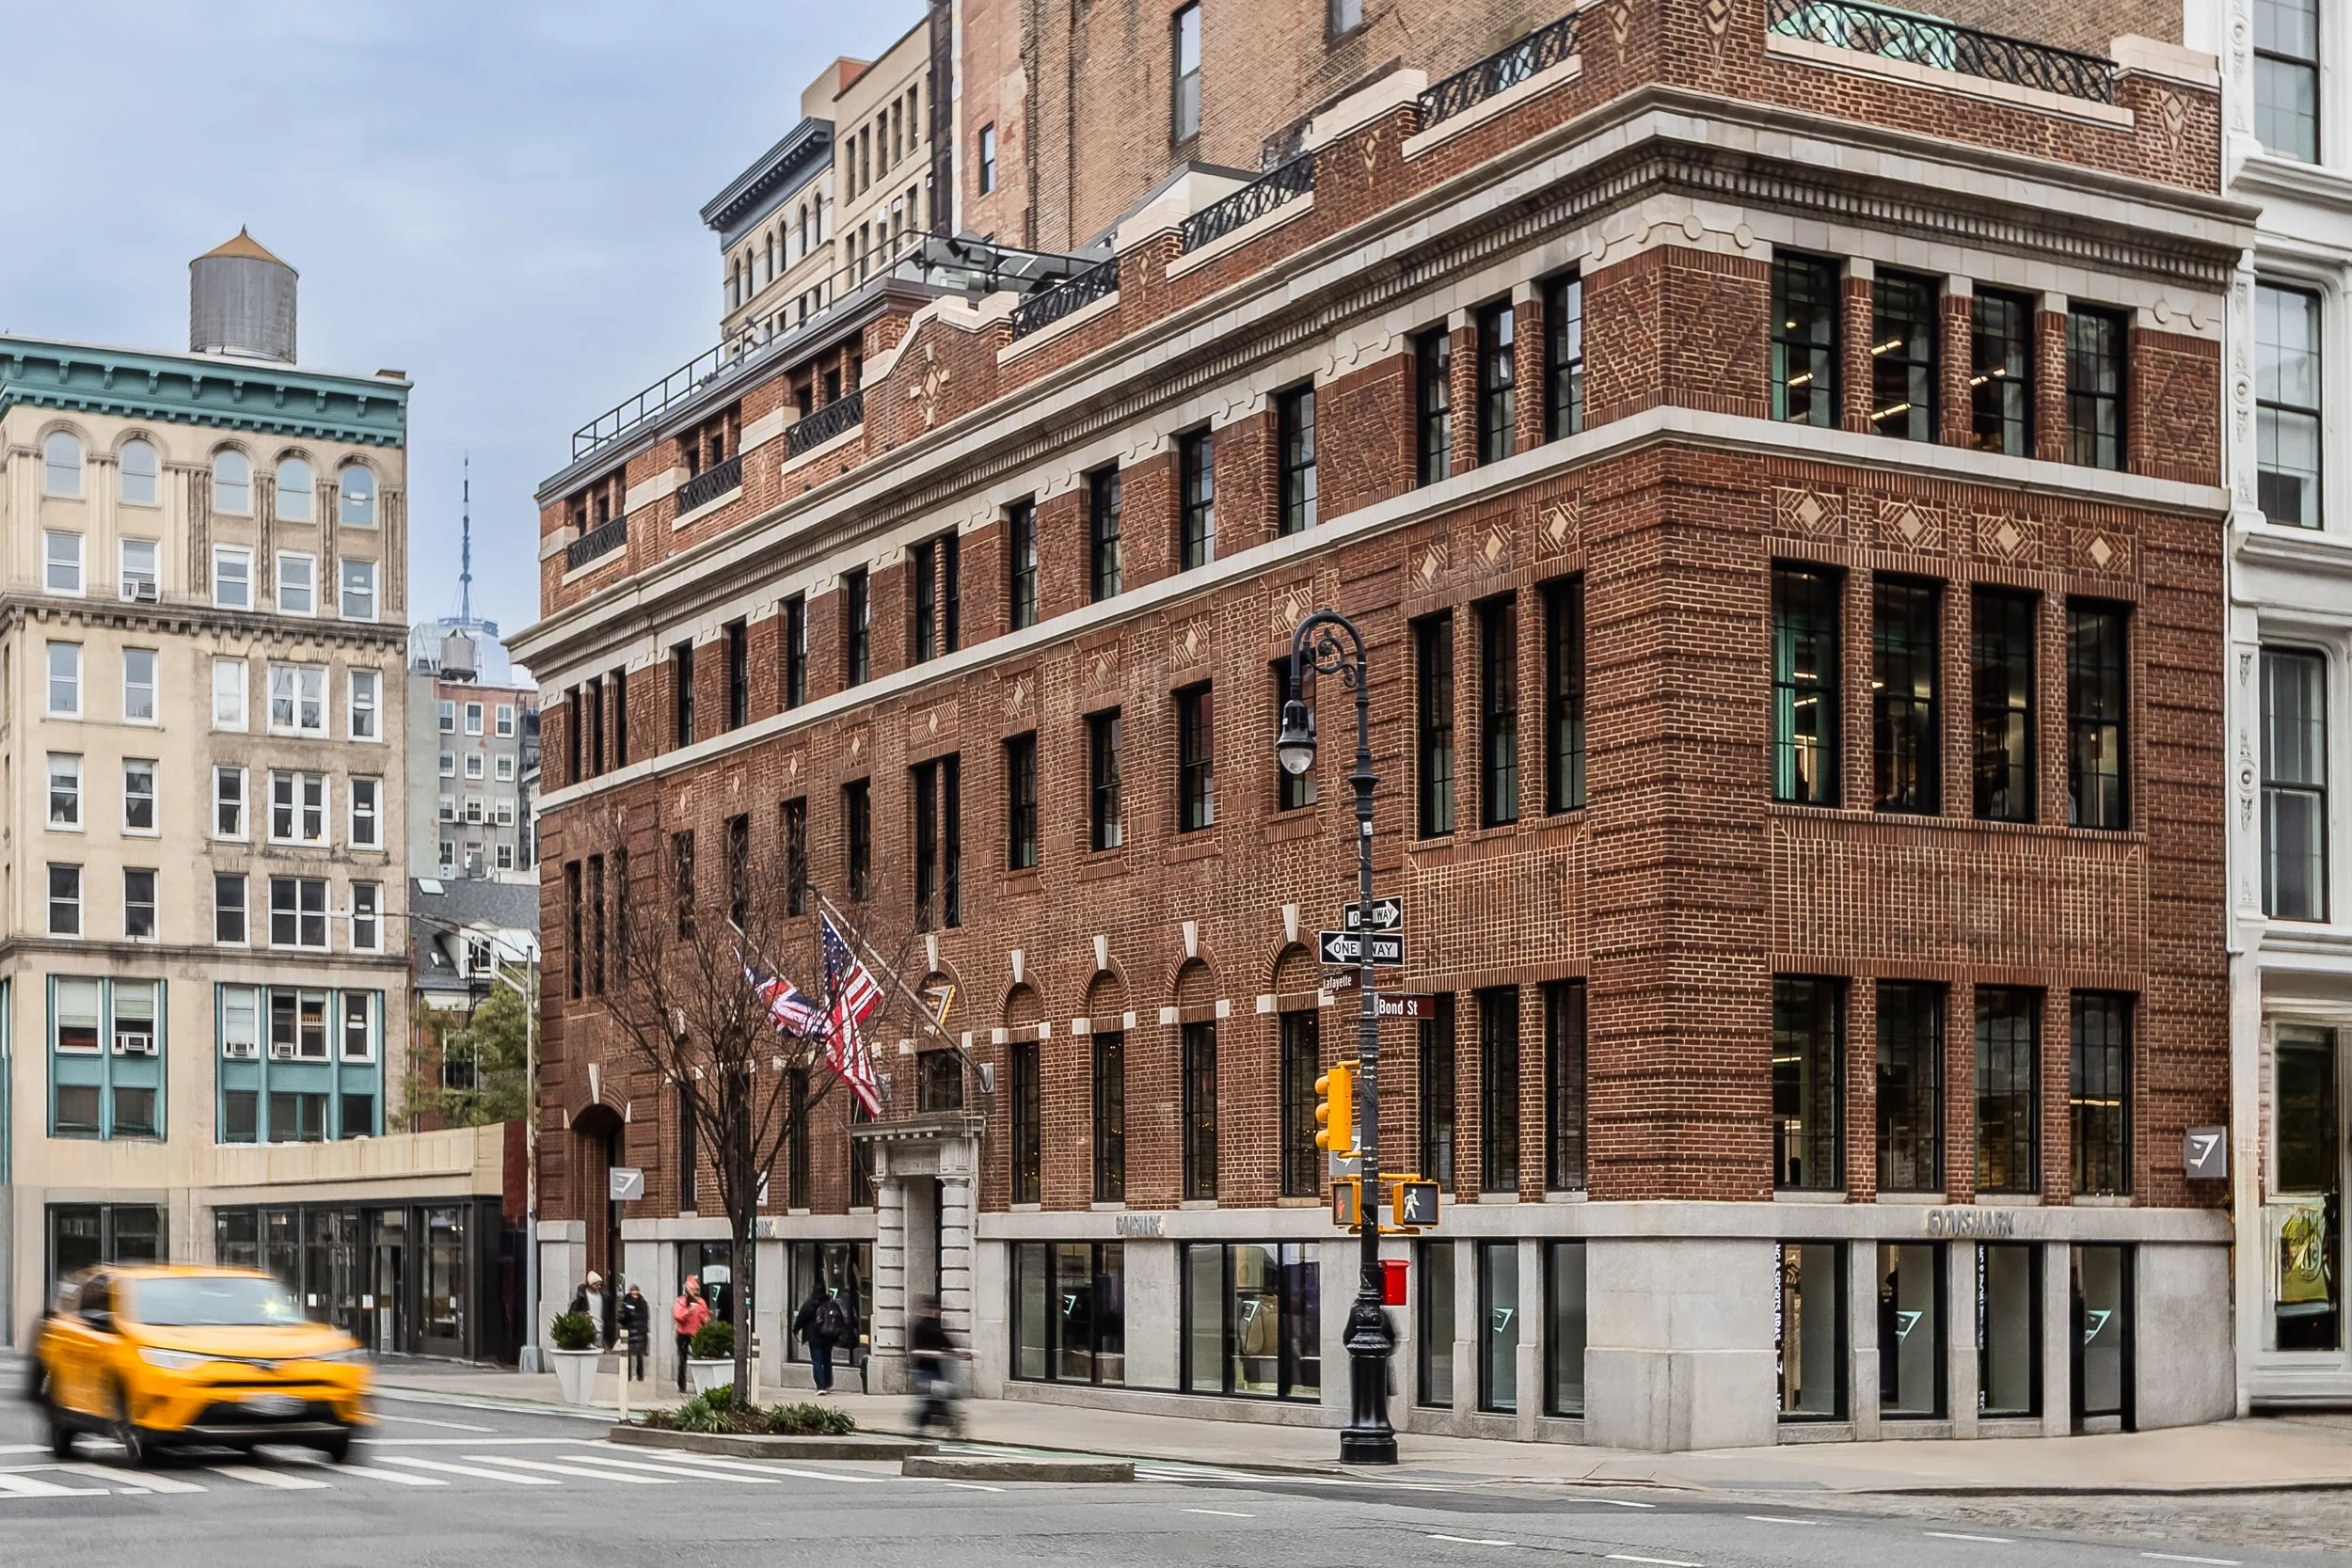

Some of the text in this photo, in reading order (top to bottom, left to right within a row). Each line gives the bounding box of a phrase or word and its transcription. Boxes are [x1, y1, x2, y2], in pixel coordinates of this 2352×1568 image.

[1376, 908, 1393, 921] WAY
[1333, 942, 1358, 954] ONE
[1379, 998, 1419, 1016] Bond St
